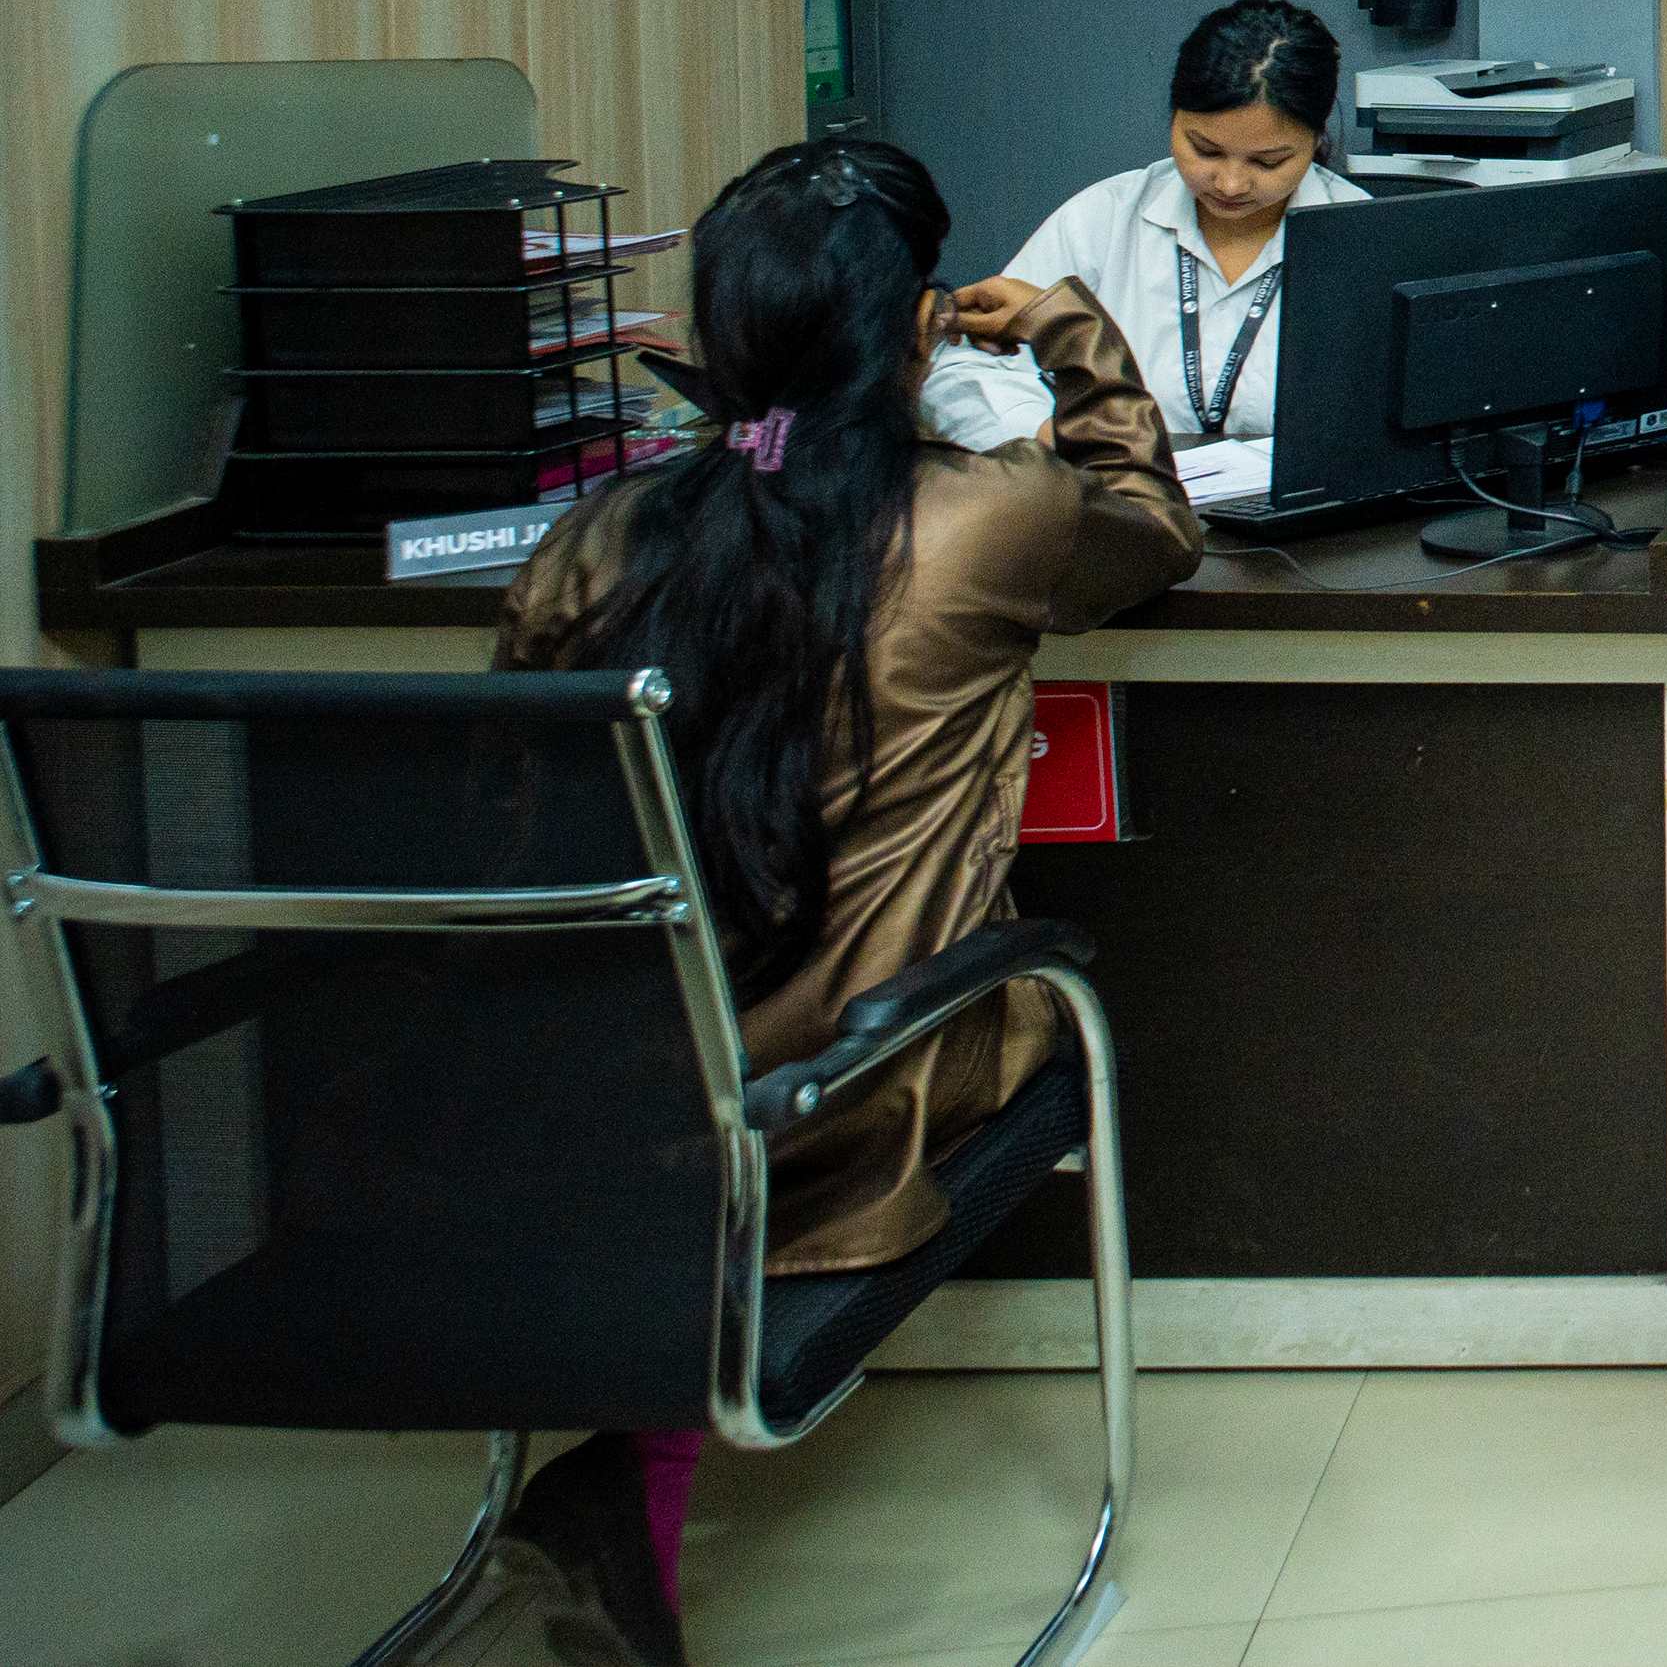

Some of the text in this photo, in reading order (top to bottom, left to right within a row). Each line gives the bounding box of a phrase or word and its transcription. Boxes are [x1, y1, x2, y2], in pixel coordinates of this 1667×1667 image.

[1183, 254, 1192, 300] VIDYAPE
[1254, 271, 1275, 304] VIDYAP
[1186, 350, 1199, 408] VIDYAPEETH
[1211, 351, 1238, 408] VIDYAPEETH
[401, 526, 516, 560] KHUSHI
